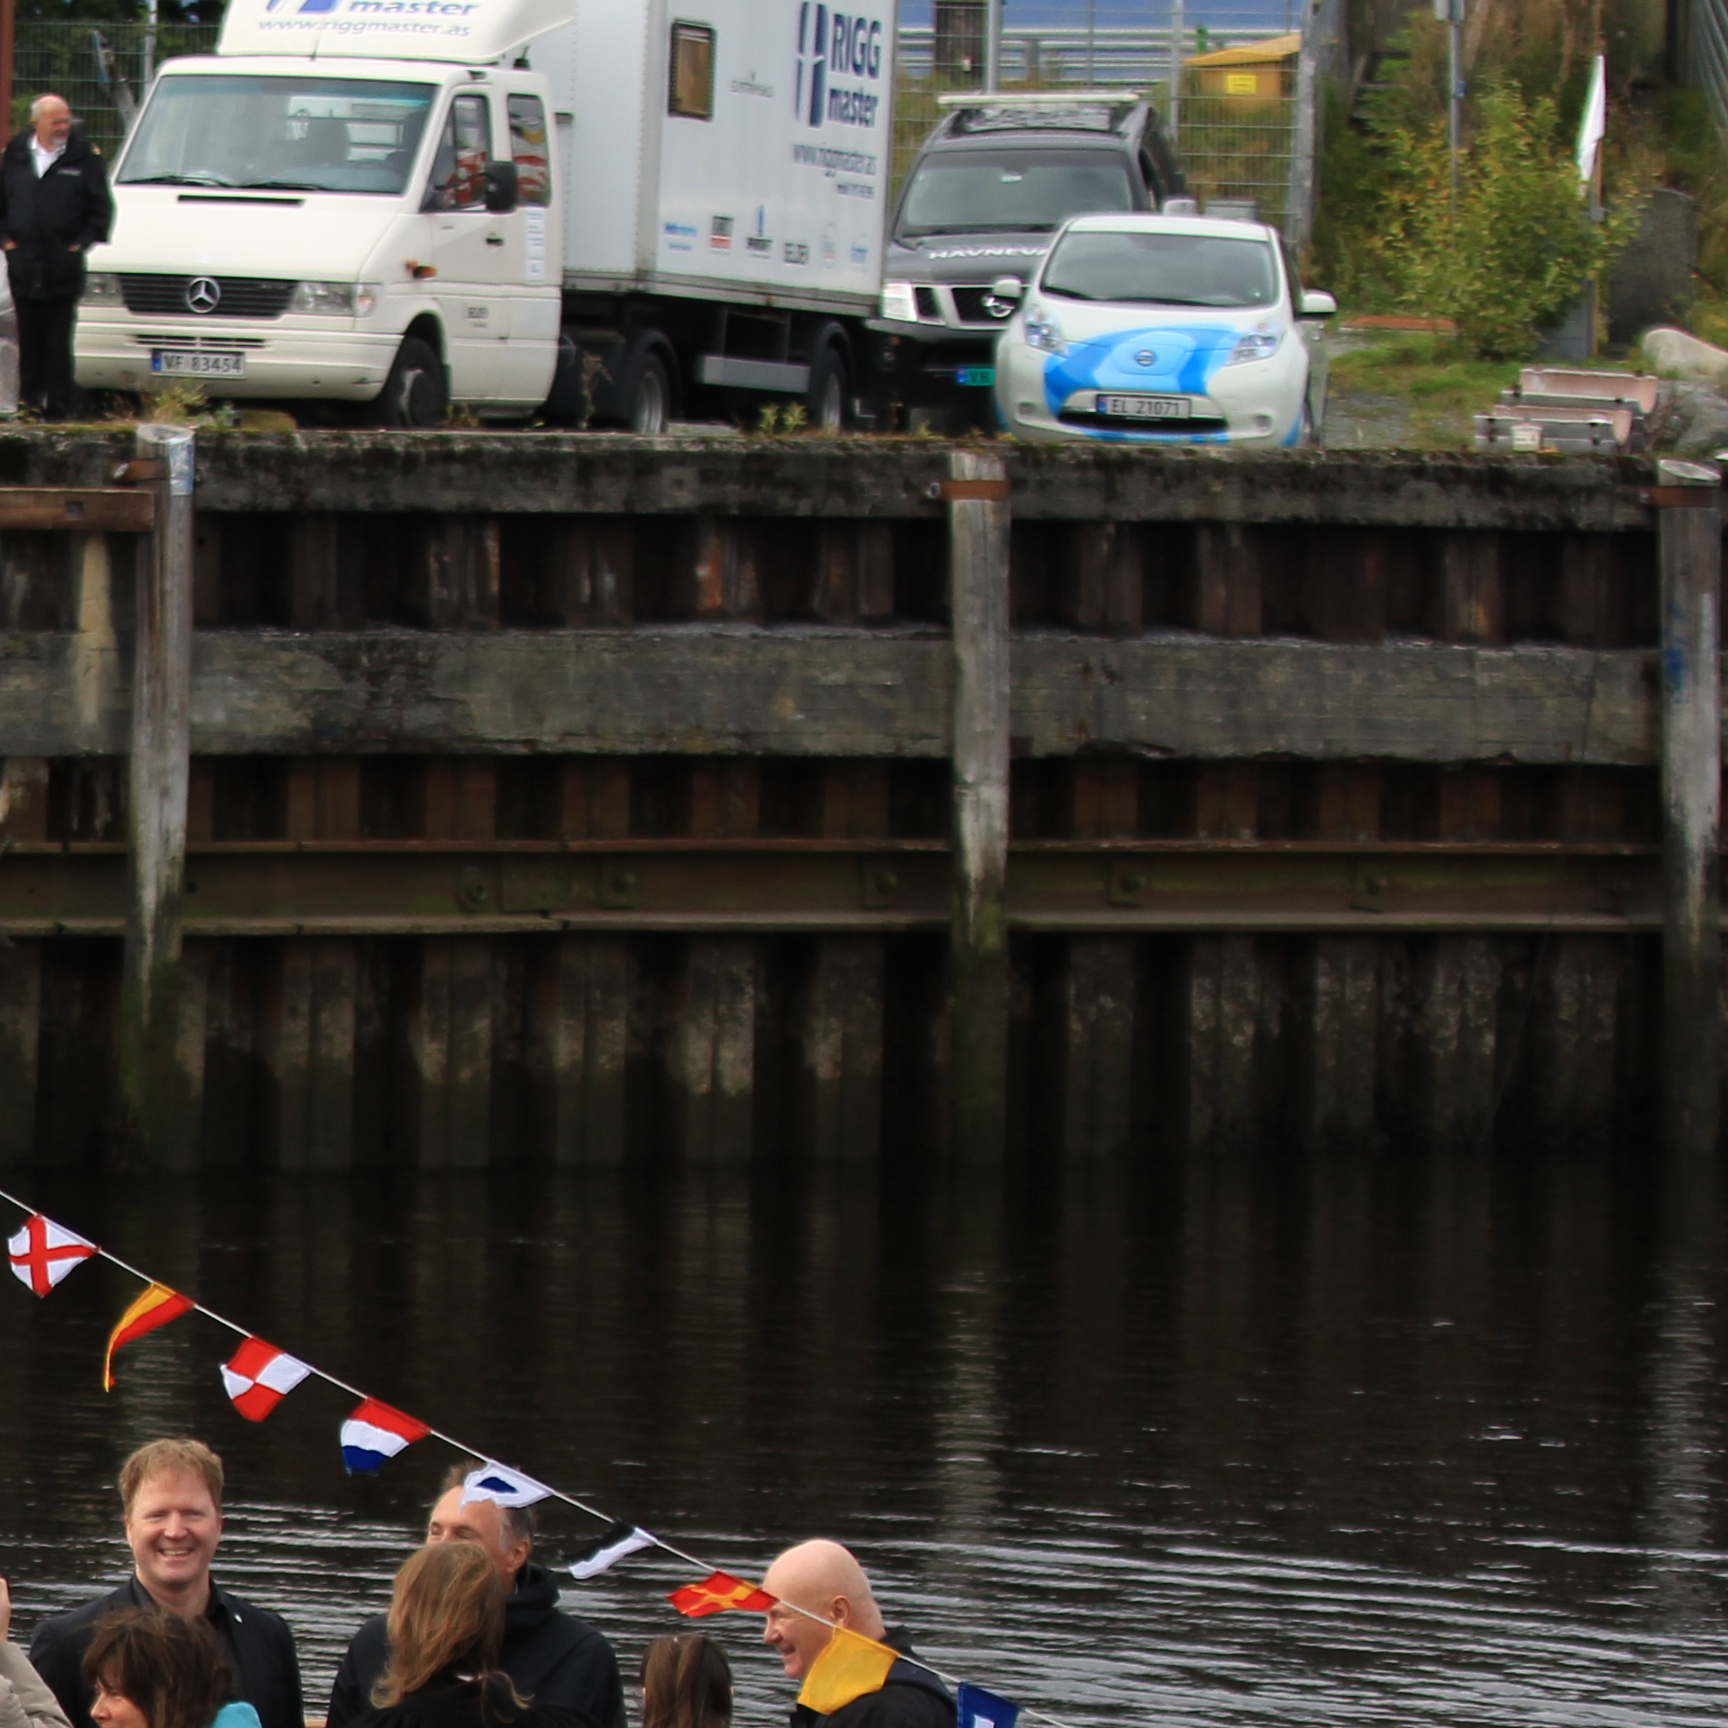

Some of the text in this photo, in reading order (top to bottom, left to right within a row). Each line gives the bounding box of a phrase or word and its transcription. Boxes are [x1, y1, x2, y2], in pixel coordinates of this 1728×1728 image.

[831, 13, 882, 79] RIGG
[827, 86, 879, 128] master
[164, 355, 242, 373] VF 83454
[1111, 398, 1179, 416] EL 21071
